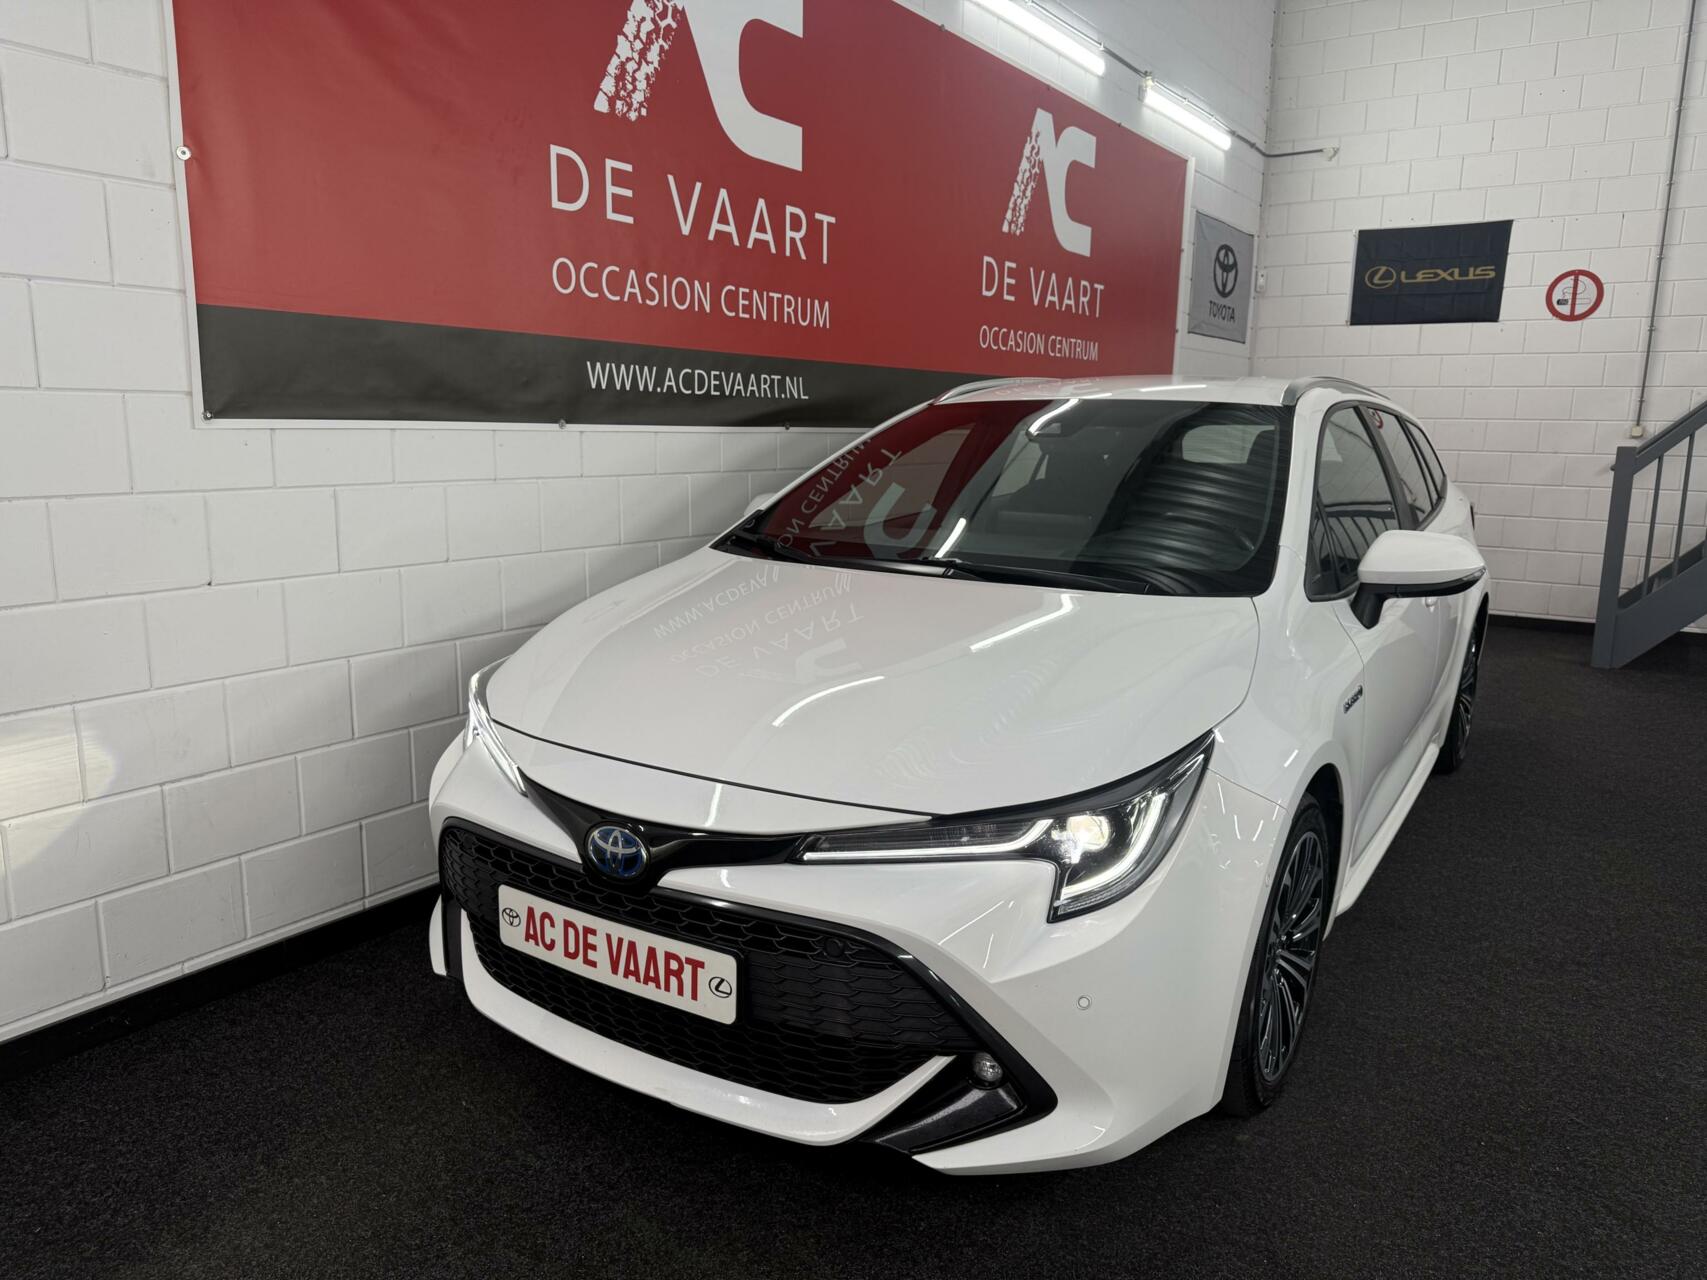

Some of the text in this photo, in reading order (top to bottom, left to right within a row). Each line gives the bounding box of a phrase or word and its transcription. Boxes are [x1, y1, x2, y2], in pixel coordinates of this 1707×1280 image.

[550, 143, 836, 264] DE VAART
[552, 256, 830, 329] OCCASION CENTRUM
[981, 255, 1104, 318] DE VAART
[1400, 265, 1496, 284] LEXUS
[1209, 300, 1236, 323] TOYOTA
[979, 325, 1099, 361] OCCASION CENTRUM
[586, 361, 809, 400] WWW.ACDEVAART.NL
[524, 906, 555, 952] AC
[563, 919, 598, 969] DE
[606, 932, 705, 1001] VAART
